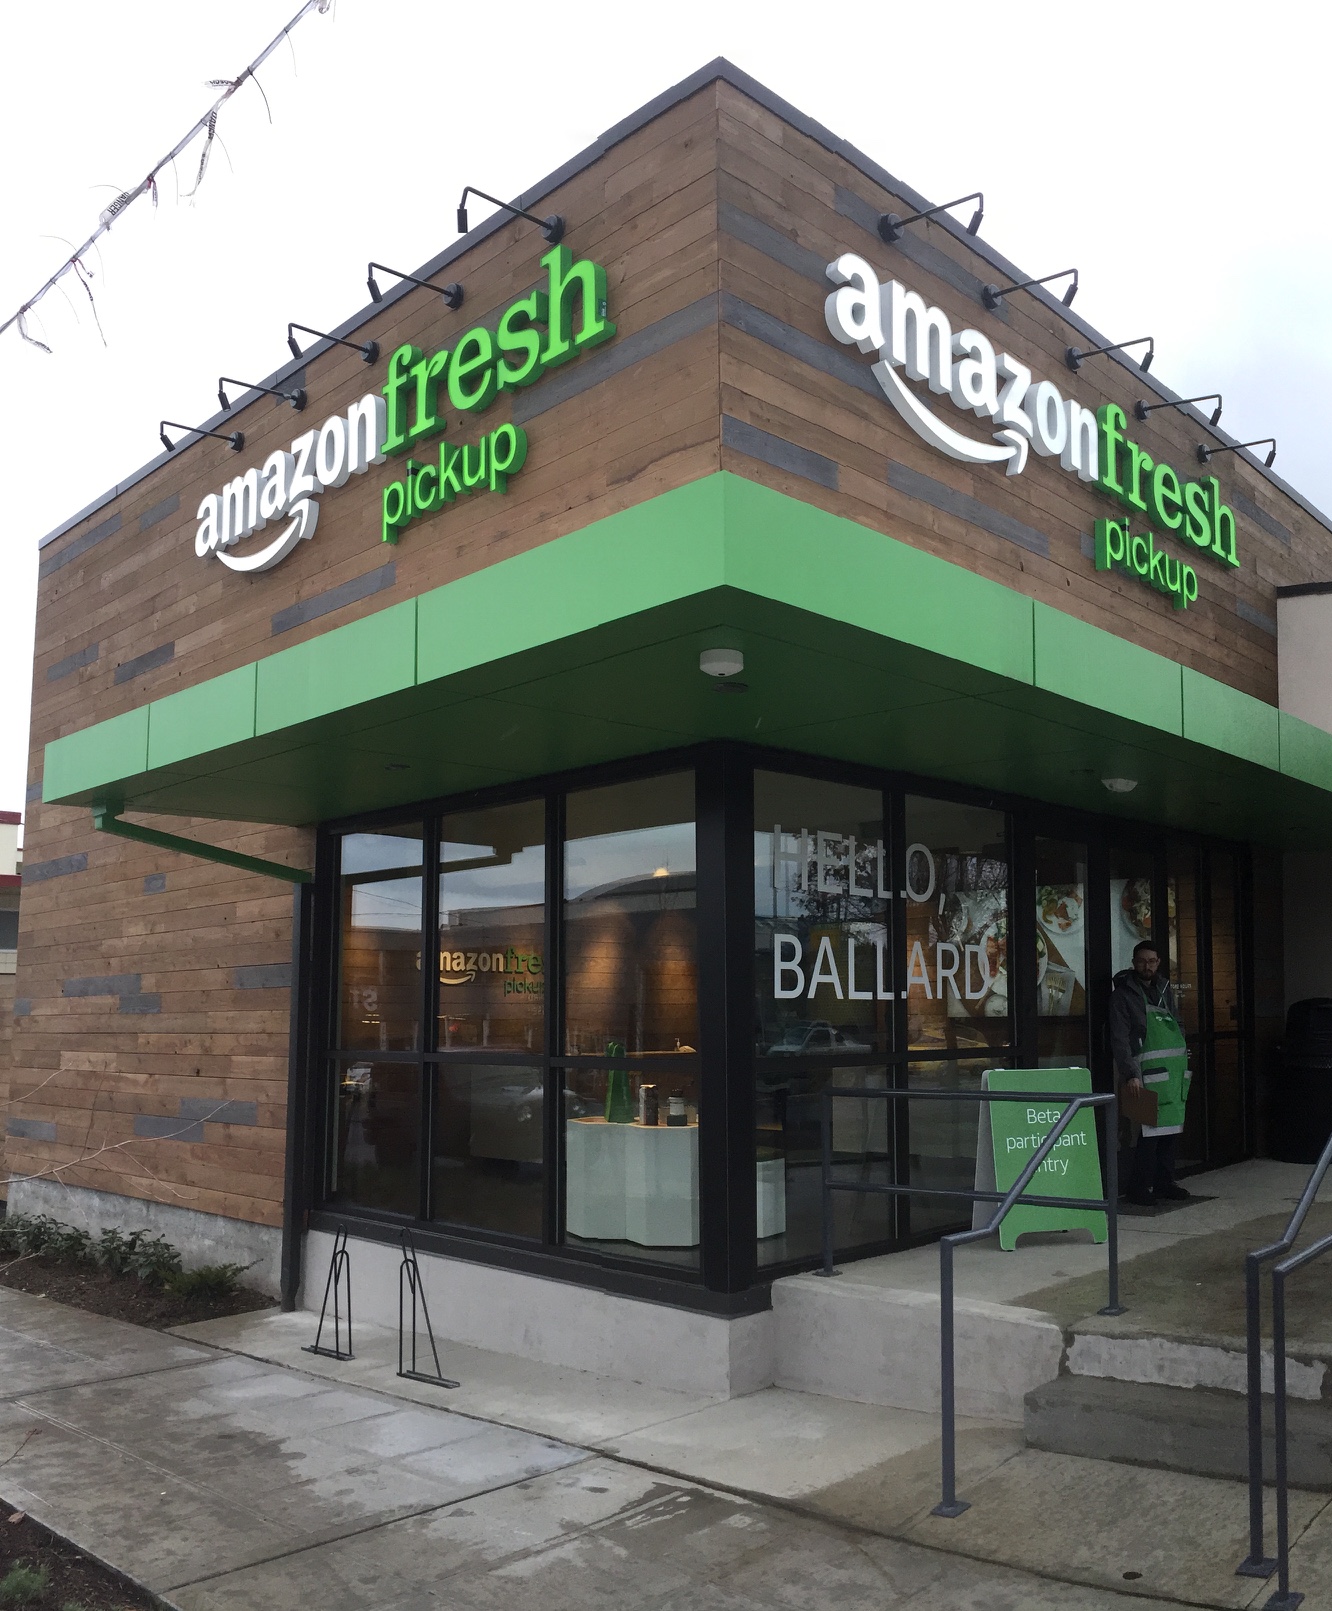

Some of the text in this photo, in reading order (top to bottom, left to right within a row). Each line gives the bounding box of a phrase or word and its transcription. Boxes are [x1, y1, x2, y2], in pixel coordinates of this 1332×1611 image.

[107, 191, 129, 216] DANGER
[382, 423, 527, 543] pickup
[1094, 517, 1198, 609] pickup
[774, 933, 991, 1000] BALLARD
[1026, 1109, 1061, 1124] Beta
[1006, 1131, 1087, 1153] partipant
[1036, 1158, 1069, 1176] ntry
